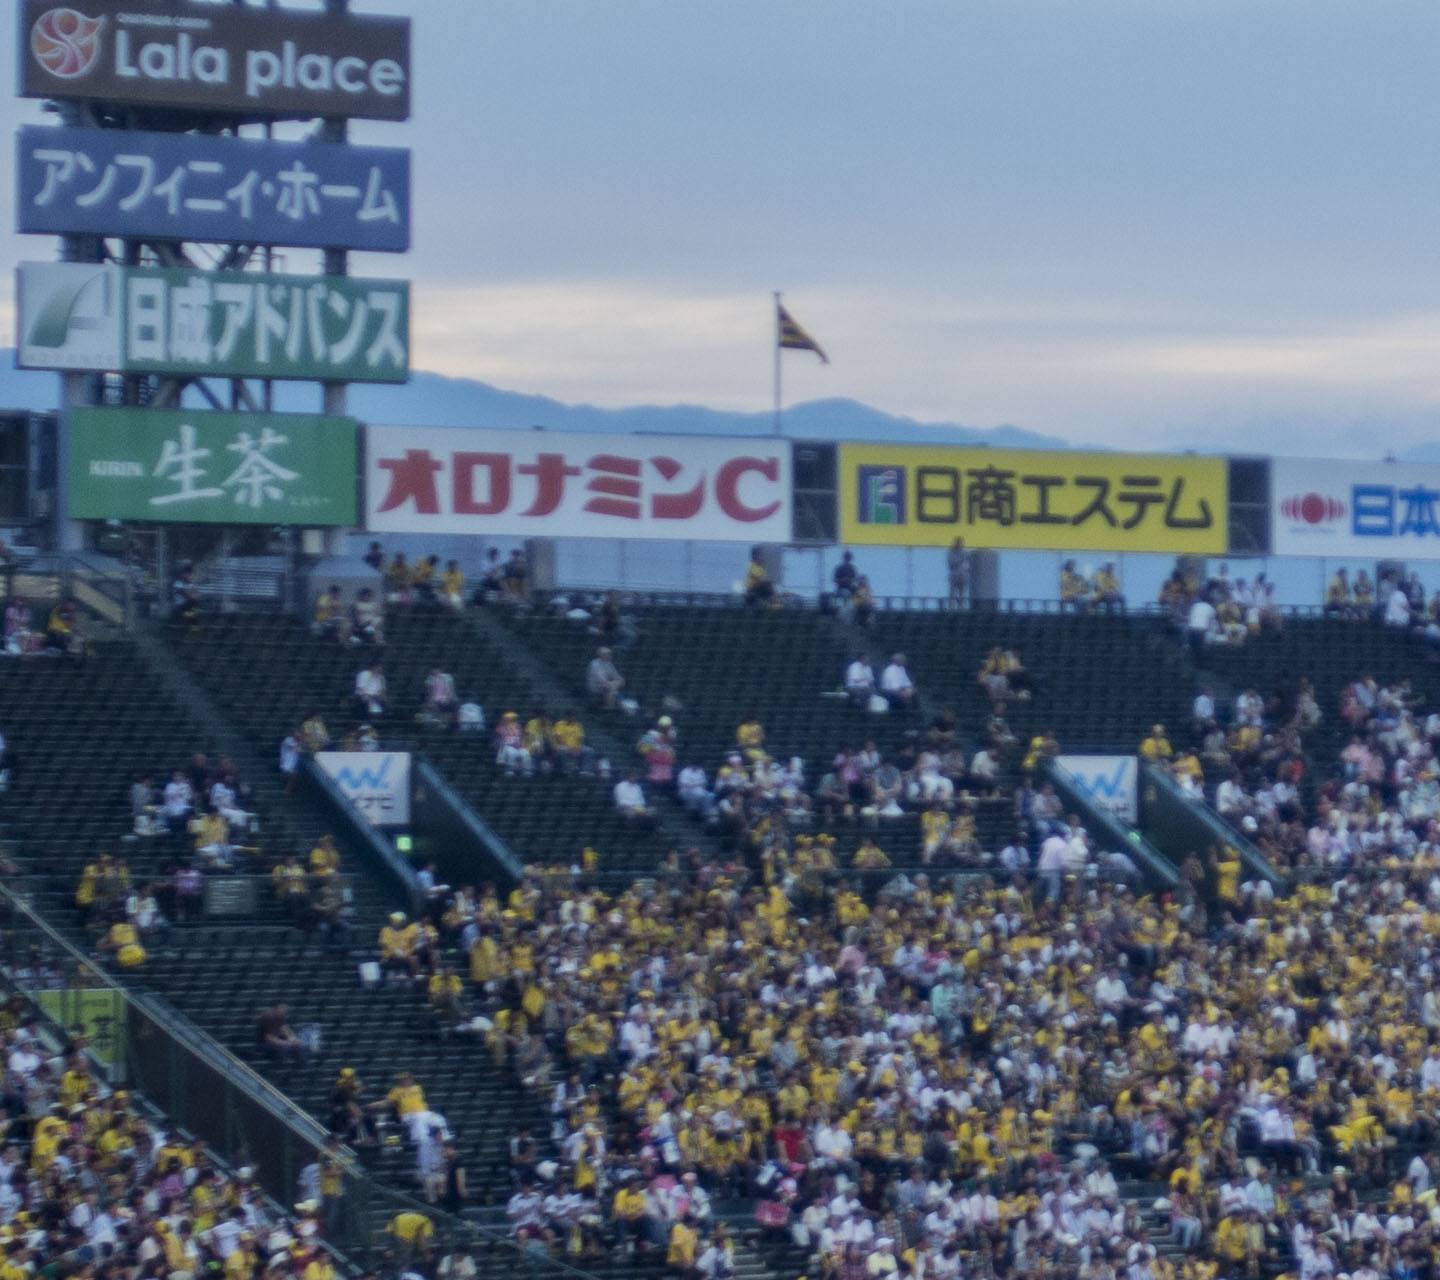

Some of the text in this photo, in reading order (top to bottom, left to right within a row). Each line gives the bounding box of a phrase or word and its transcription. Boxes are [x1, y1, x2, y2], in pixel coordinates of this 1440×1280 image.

[115, 29, 406, 98] Lala place
[147, 423, 302, 509] 生茶
[375, 447, 785, 526] オロナミンC
[916, 463, 1216, 533] 日商エステム
